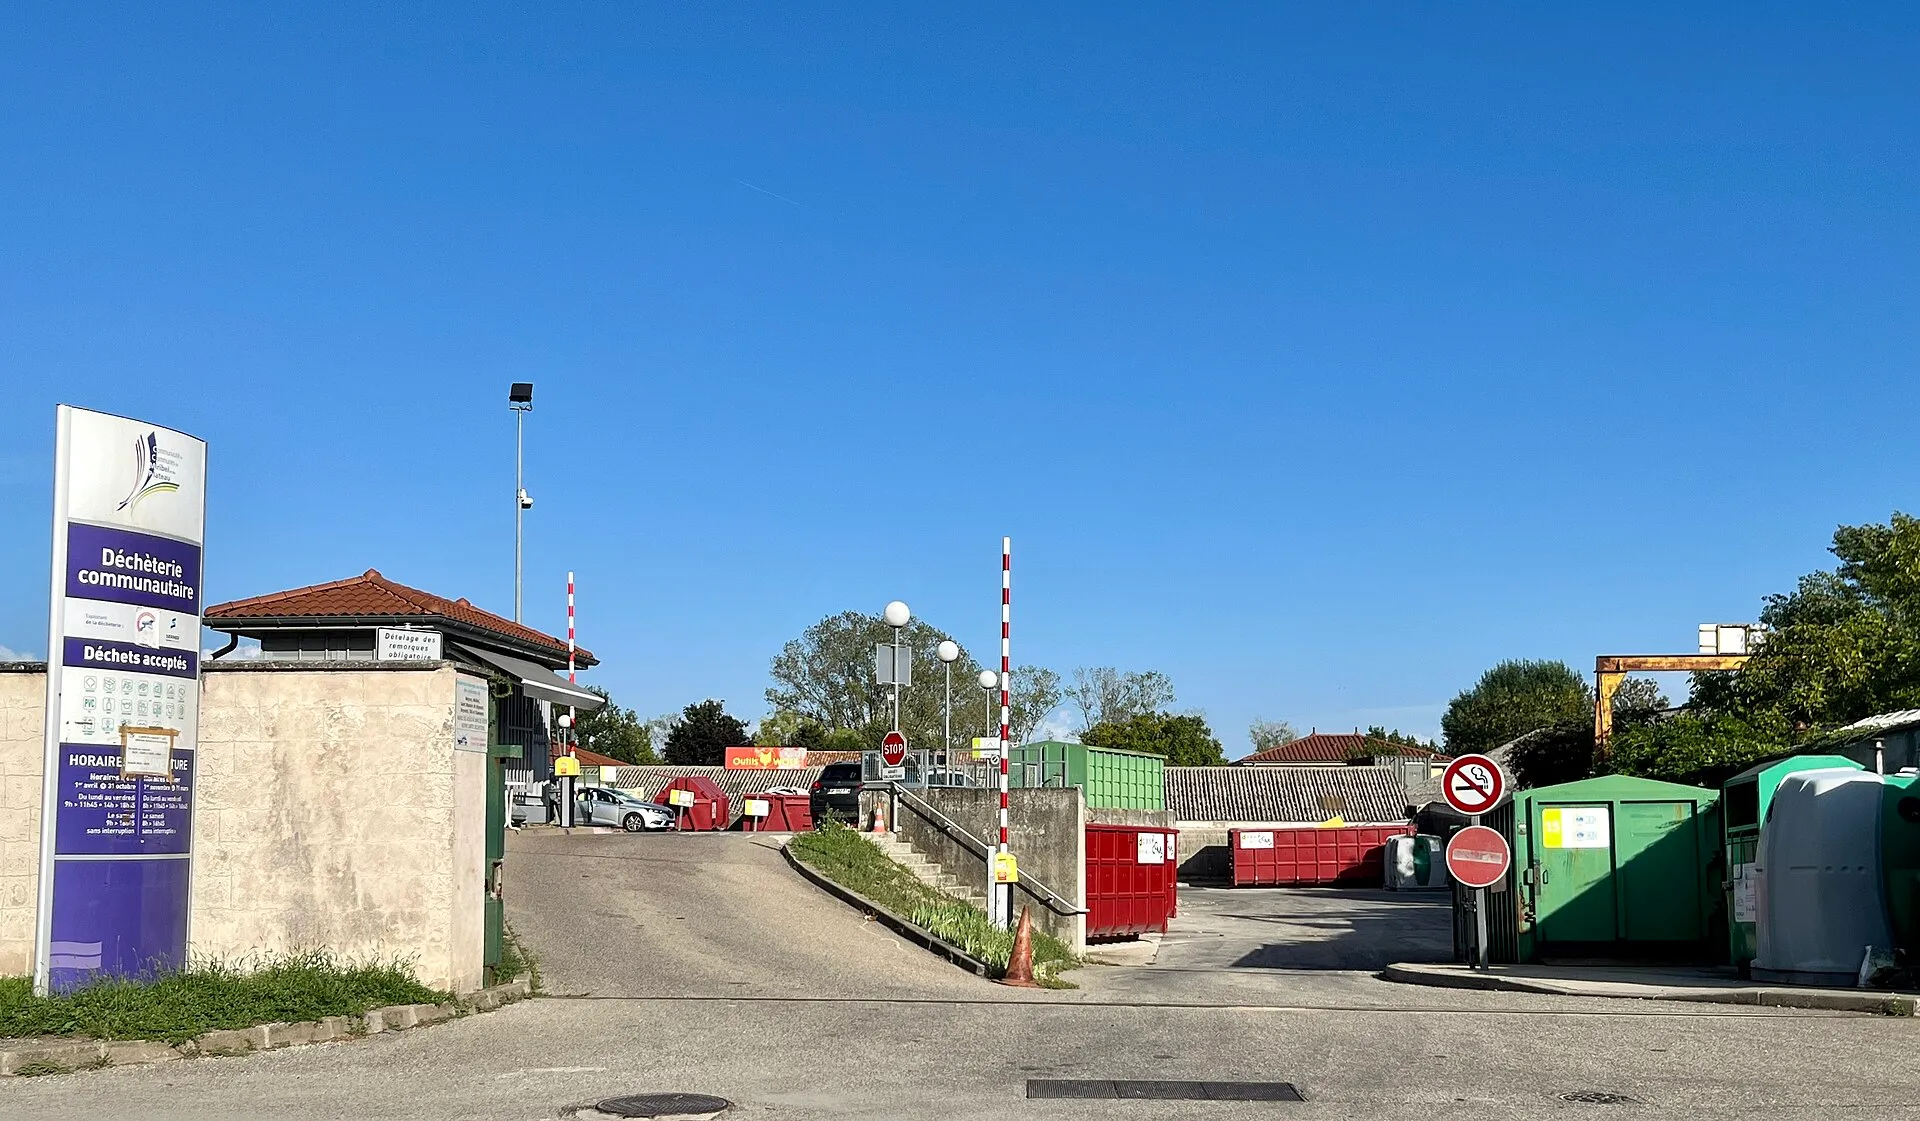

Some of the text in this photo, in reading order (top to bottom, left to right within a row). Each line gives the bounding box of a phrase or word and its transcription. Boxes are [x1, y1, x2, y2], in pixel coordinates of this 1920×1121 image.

[102, 548, 183, 578] Déchèterie
[78, 569, 194, 600] communautaire
[385, 632, 419, 643] Dételage
[389, 643, 429, 652] remorques
[84, 645, 187, 671] Déchets acceptés
[389, 652, 432, 660] obligatoire
[884, 743, 904, 755] STOP
[69, 754, 125, 768] HORAIRE
[732, 757, 759, 766] Outils
[90, 772, 120, 781] Horaires
